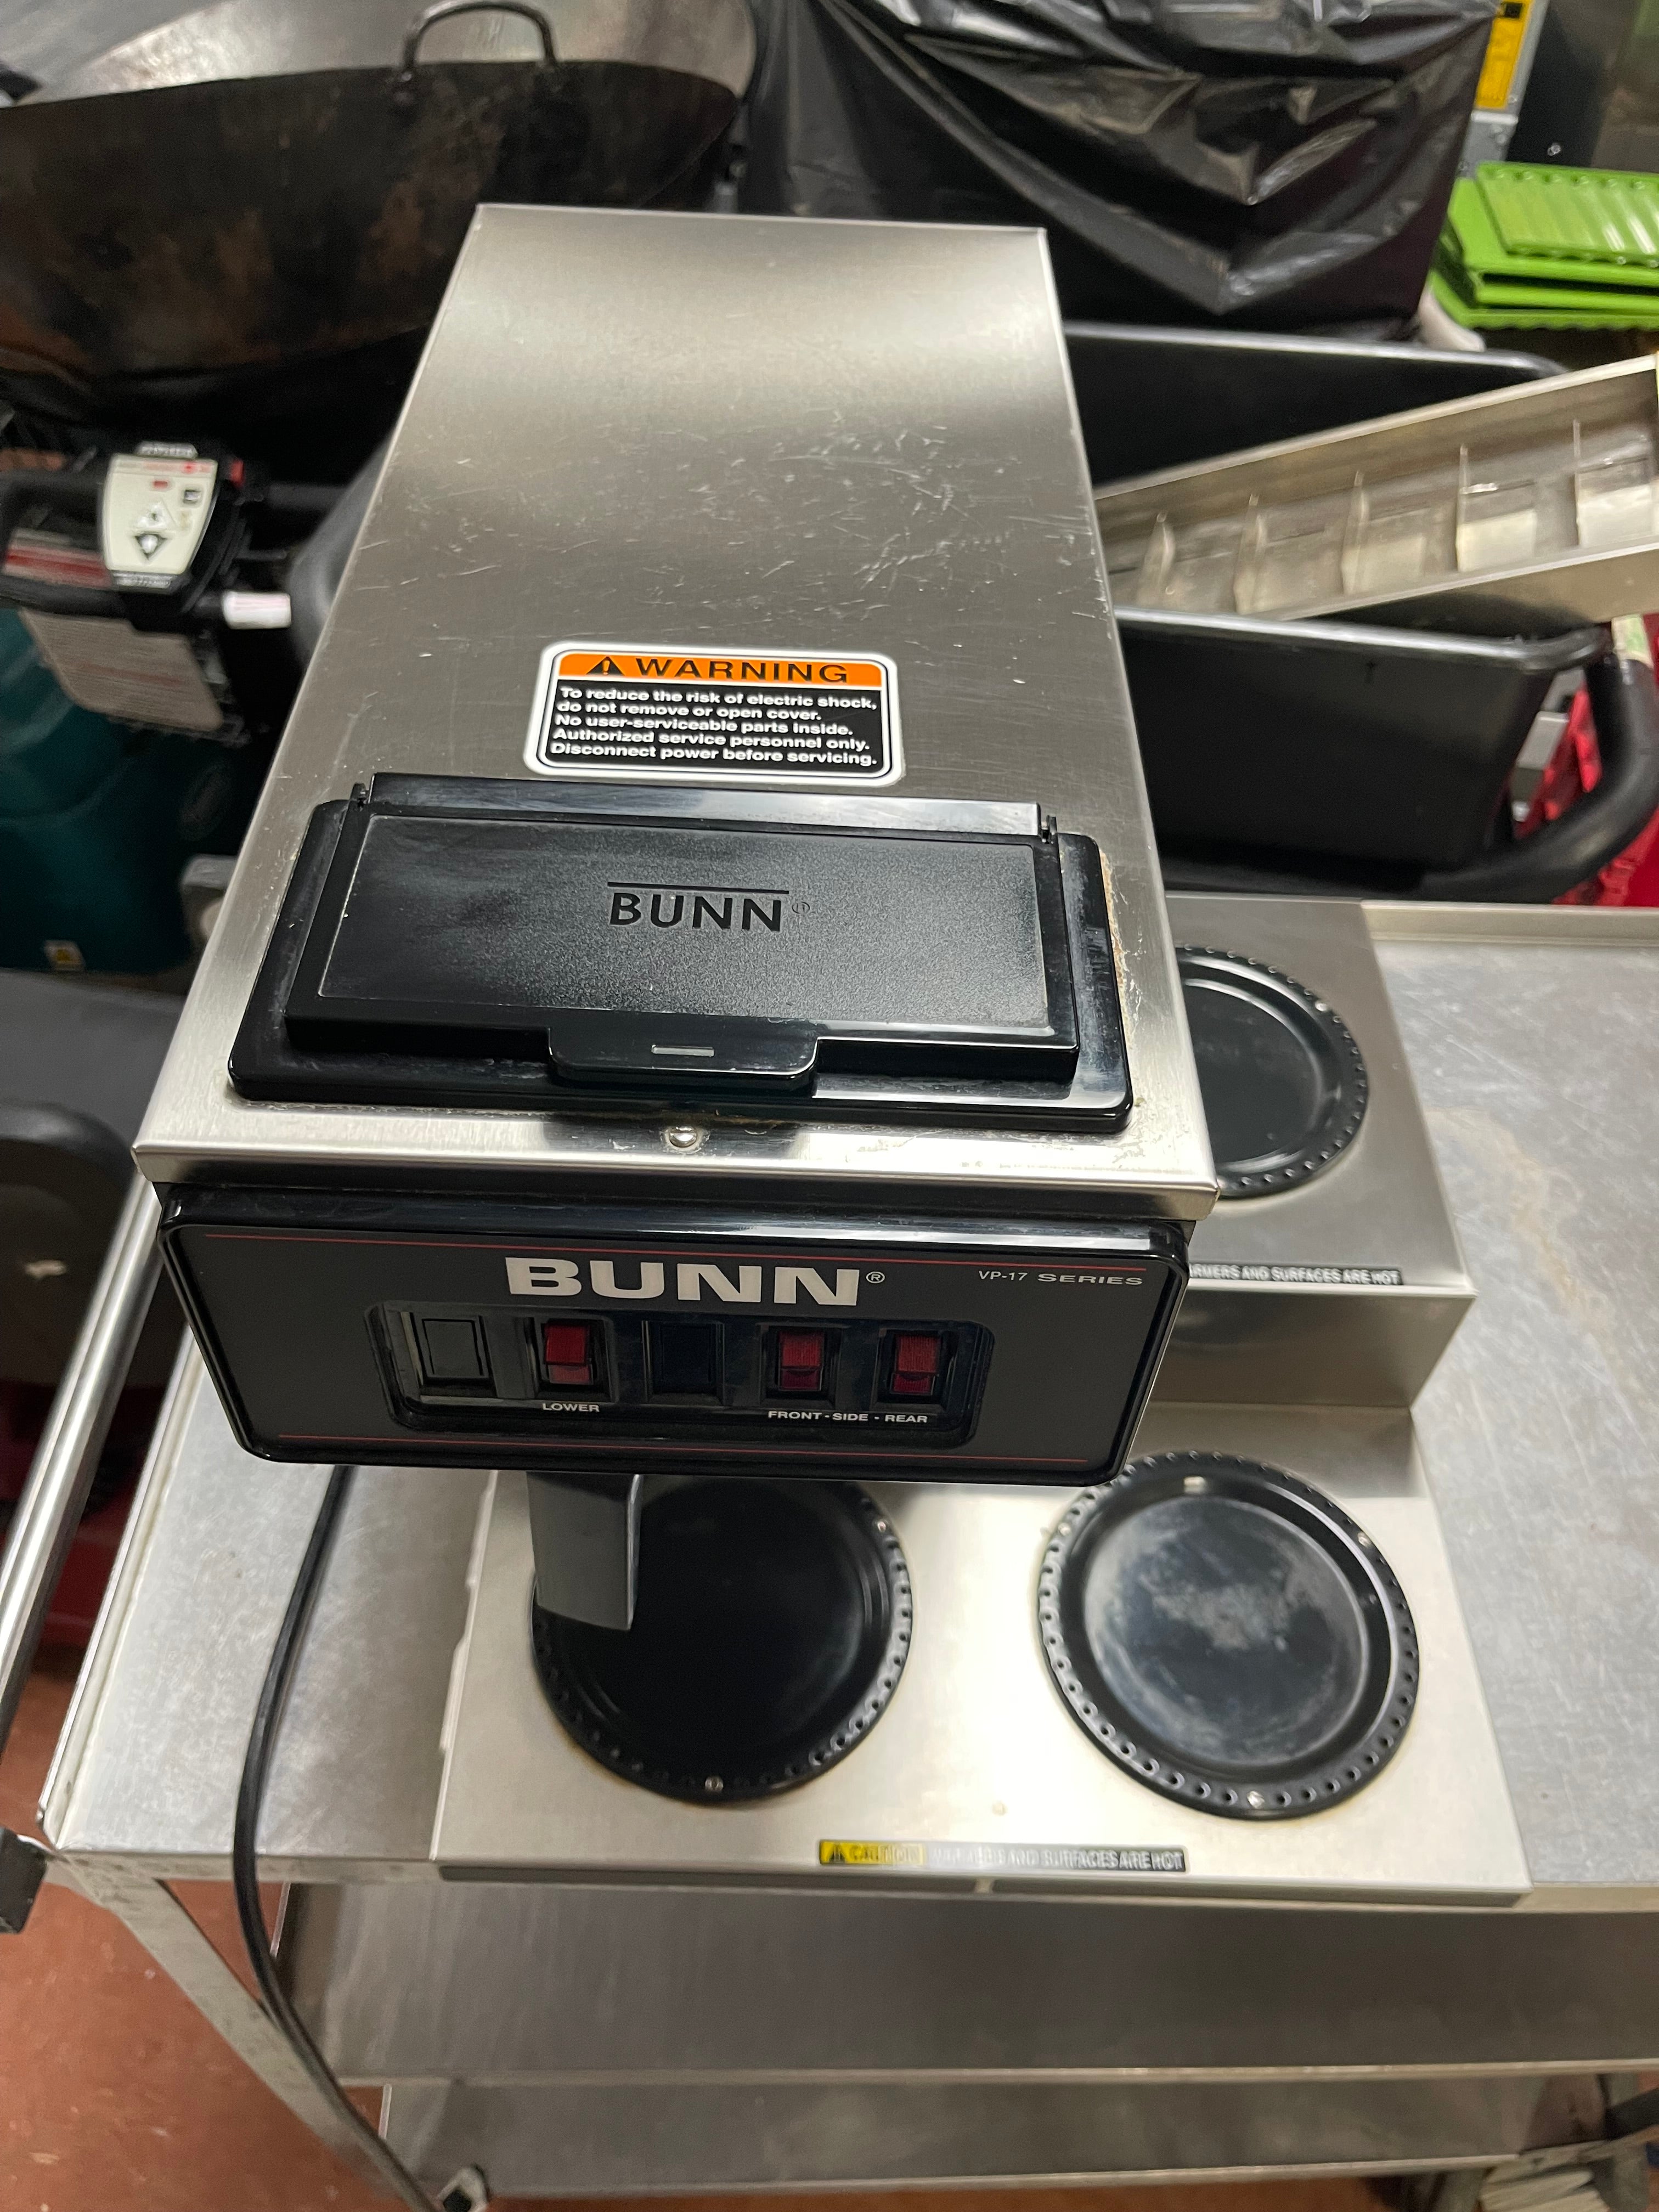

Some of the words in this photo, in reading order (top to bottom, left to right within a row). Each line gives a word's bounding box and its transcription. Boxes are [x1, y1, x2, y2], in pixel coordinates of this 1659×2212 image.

[635, 658, 848, 682] WARNING
[556, 700, 582, 712] do
[585, 702, 617, 714] not
[620, 703, 690, 716] remove
[692, 706, 714, 716] or
[716, 707, 763, 720] open
[766, 709, 822, 720] cover.
[560, 686, 583, 698] To
[585, 688, 650, 701] reduce
[652, 690, 683, 702] the
[686, 691, 720, 704] risk
[724, 692, 743, 704] of
[746, 693, 814, 707] electric
[817, 696, 877, 710] shock,
[555, 713, 582, 726] No
[585, 716, 738, 731] user-serviceable
[741, 721, 788, 734] parts
[792, 721, 853, 736] inside.
[553, 727, 655, 743] Authorized
[658, 732, 726, 746] service
[729, 735, 822, 748] personnel
[826, 738, 871, 752] only.
[550, 742, 657, 758] Disconnect
[660, 746, 719, 760] power
[722, 747, 783, 761] before
[787, 752, 877, 767] servicing.
[610, 892, 782, 932] BUNN
[505, 1257, 860, 1307] BUNN
[979, 1270, 1028, 1281] VP-17
[1037, 1273, 1143, 1286] SERIES
[1242, 1265, 1271, 1281] AND
[1271, 1266, 1342, 1283] SURFACES
[1343, 1269, 1371, 1284] ARE
[1372, 1269, 1401, 1285] HOT
[542, 1403, 600, 1413] LOWER
[768, 1410, 820, 1420] FRONT
[832, 1413, 868, 1422] SIDE
[884, 1414, 928, 1424] REAR
[1007, 1847, 1040, 1866] AND
[1040, 1847, 1119, 1869] SURFACES
[1119, 1849, 1151, 1870] ARE
[1151, 1849, 1184, 1871] HOT
